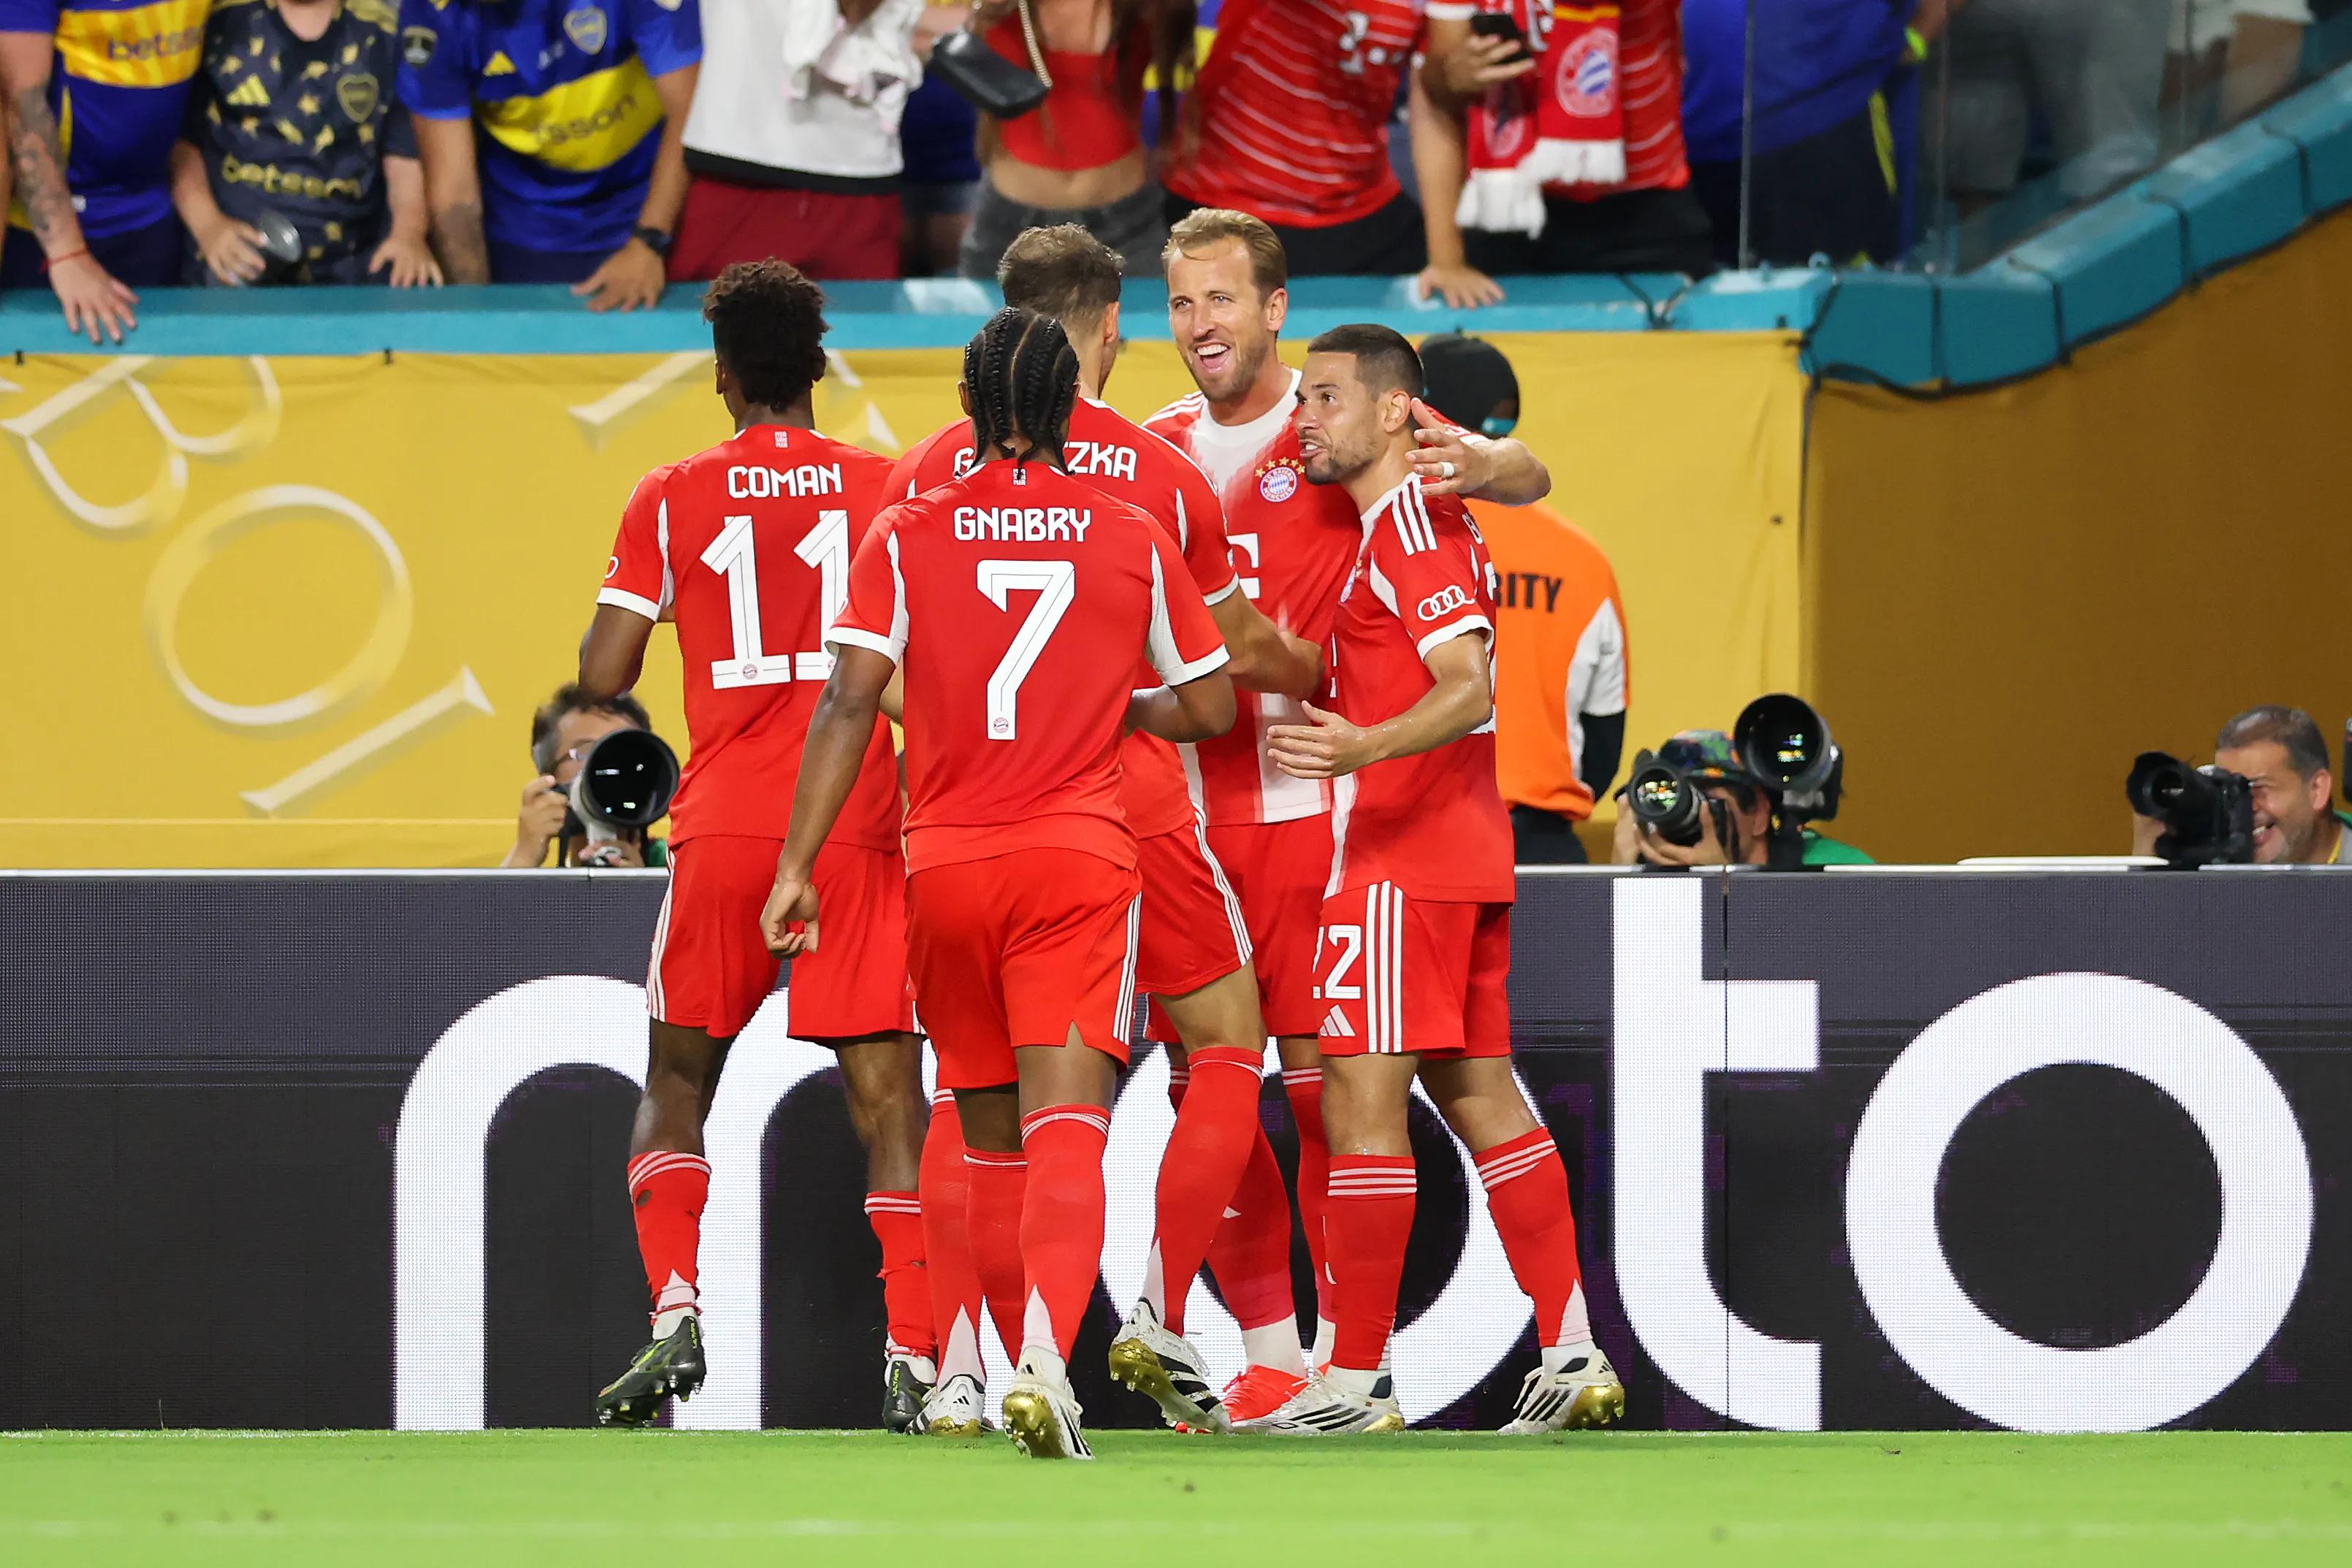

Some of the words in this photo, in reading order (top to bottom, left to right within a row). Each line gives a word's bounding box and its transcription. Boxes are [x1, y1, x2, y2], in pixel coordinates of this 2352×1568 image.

[728, 463, 843, 498] COMAN
[954, 441, 1137, 481] GZKA
[954, 506, 1091, 543] GNABRY
[700, 509, 852, 689] 11
[977, 559, 1075, 741] 7
[1313, 925, 1362, 999] 2
[394, 876, 2313, 1432] moto
